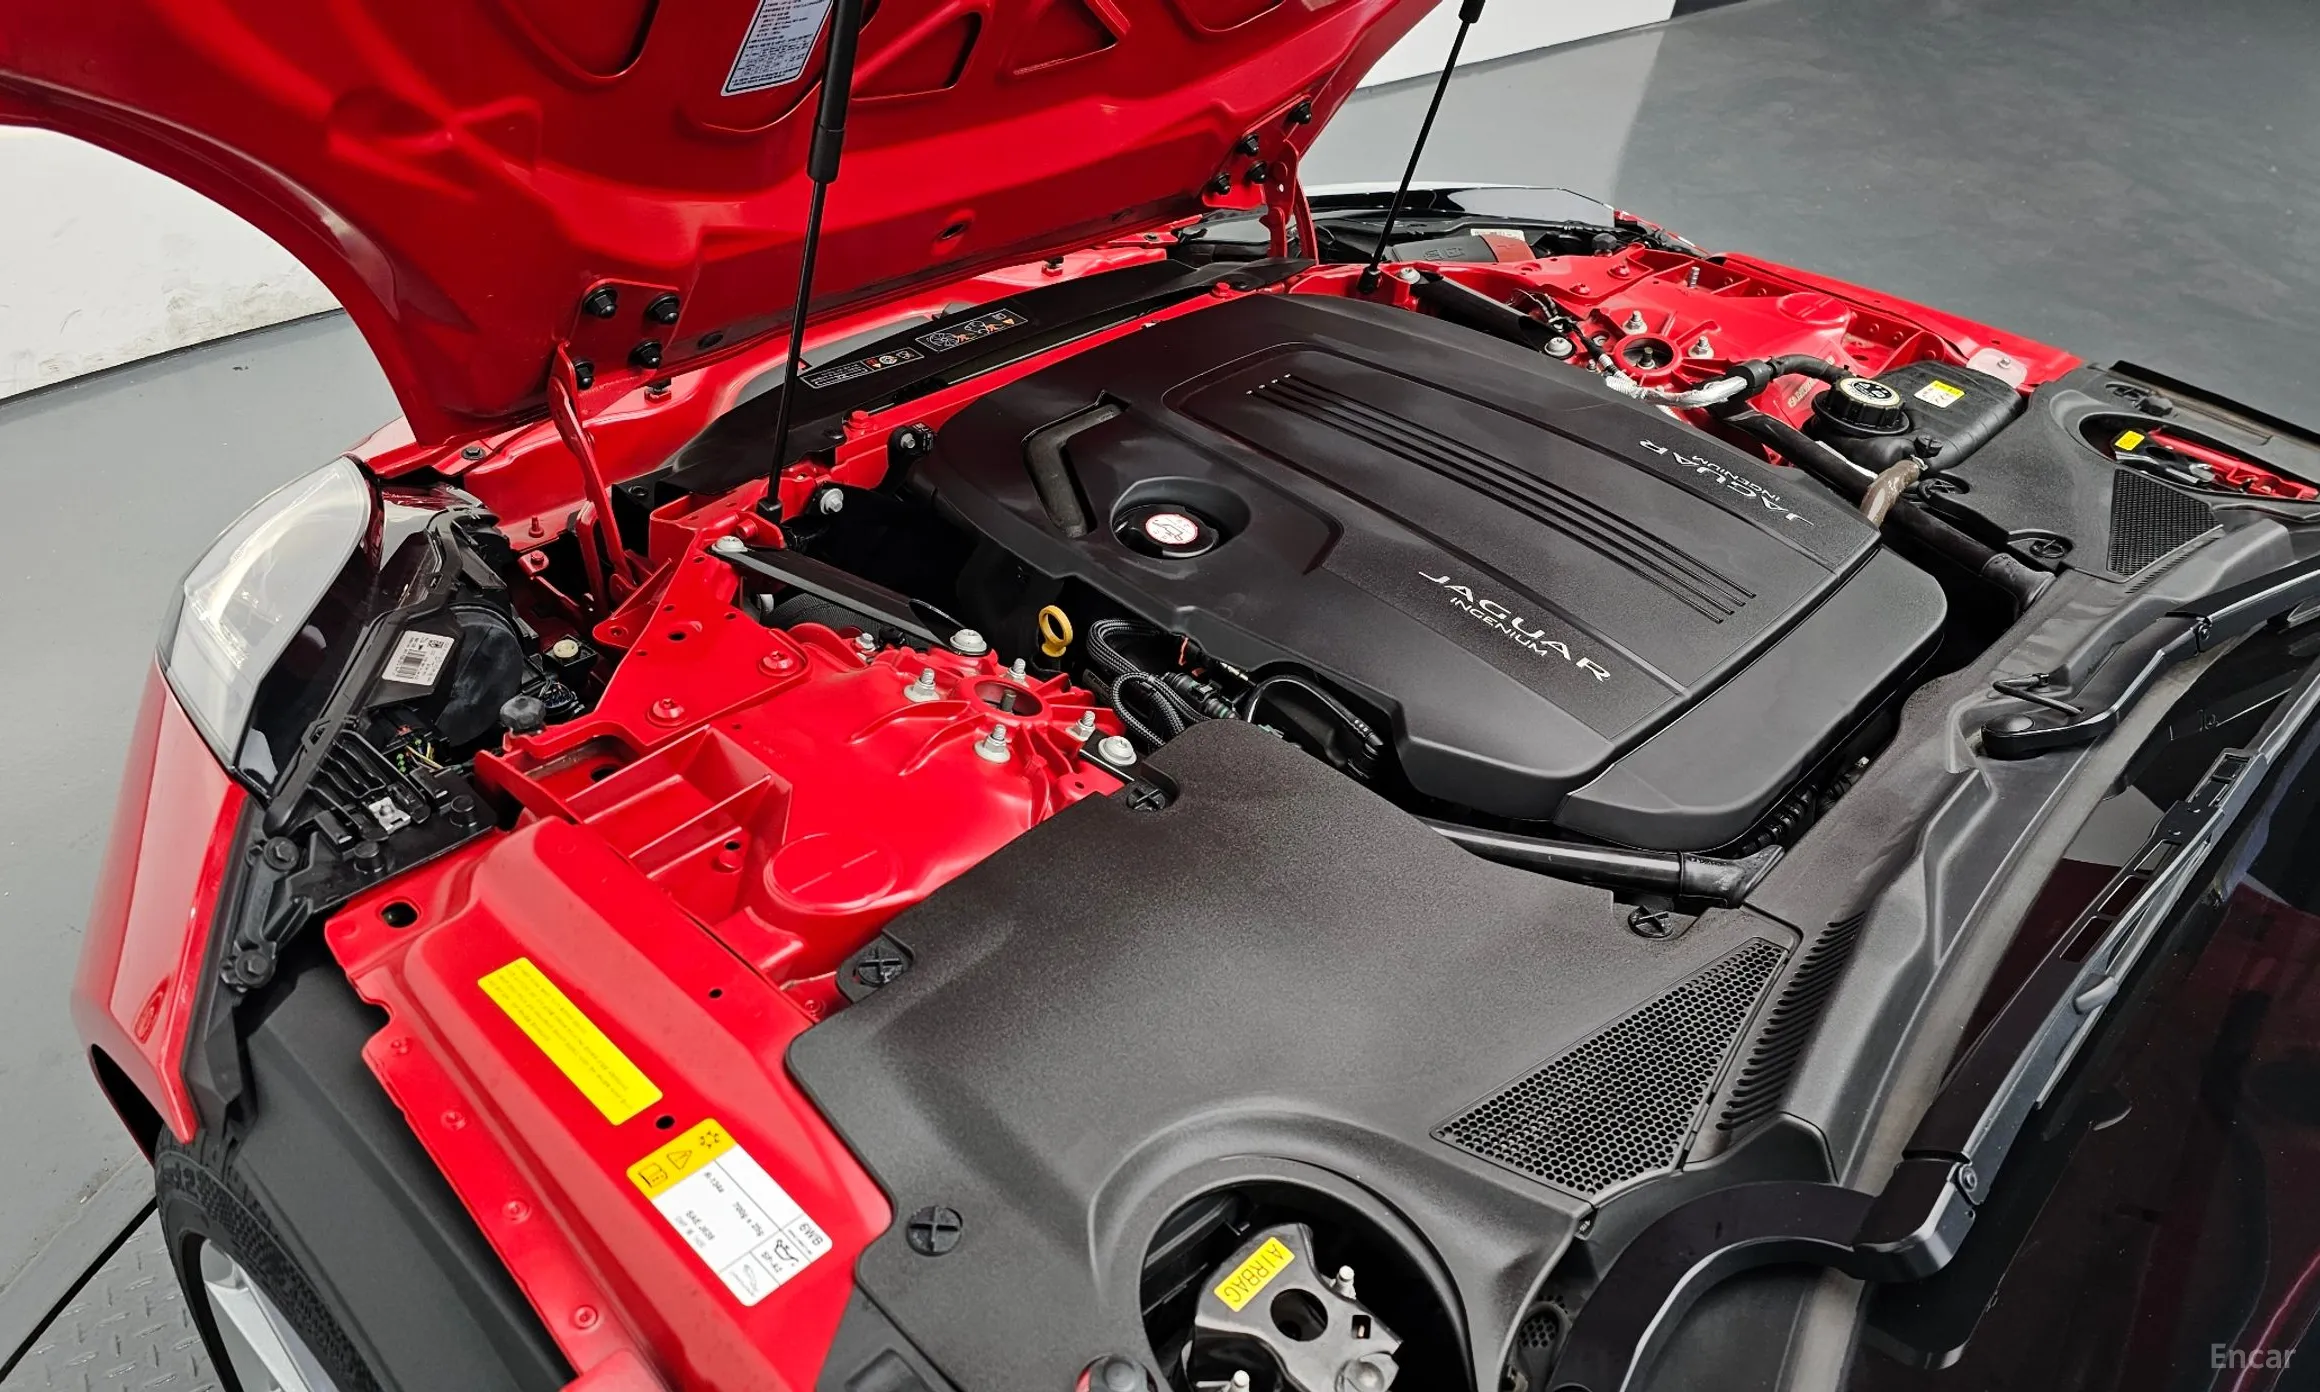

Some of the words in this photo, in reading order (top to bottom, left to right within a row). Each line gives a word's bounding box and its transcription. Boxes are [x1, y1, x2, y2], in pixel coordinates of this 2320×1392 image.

[1639, 439, 1815, 527] JAGUAR
[1692, 456, 1780, 501] INGENIUM
[1418, 571, 1611, 682] JAGUAR
[1450, 597, 1547, 657] INGENIUM
[1223, 1243, 1284, 1303] AIRBAG
